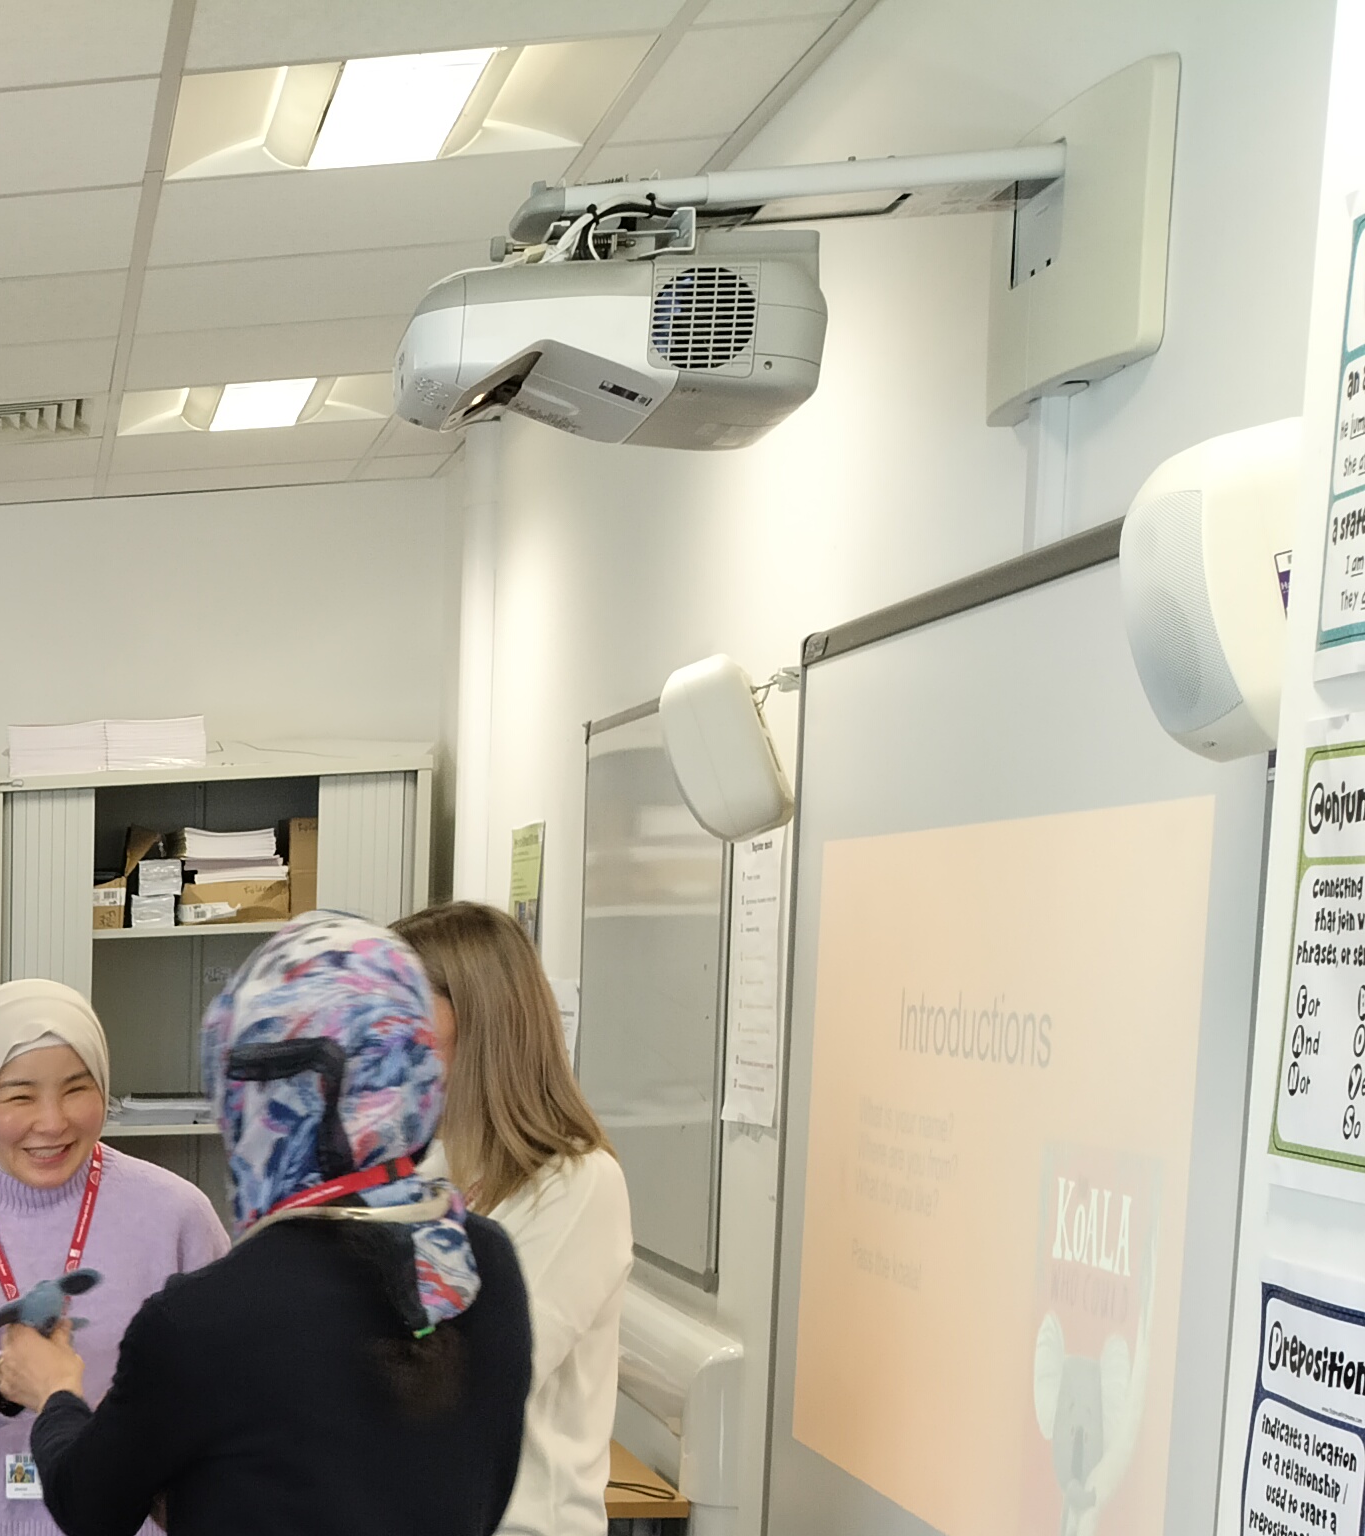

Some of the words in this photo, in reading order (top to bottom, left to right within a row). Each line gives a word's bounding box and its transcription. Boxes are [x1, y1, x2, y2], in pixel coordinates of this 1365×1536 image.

[1341, 590, 1359, 612] They
[1314, 907, 1336, 933] that
[1337, 907, 1356, 935] join
[1296, 941, 1339, 968] phrases,
[1341, 947, 1351, 965] or
[1296, 985, 1321, 1019] For
[899, 986, 1052, 1069] Introductions
[1292, 1024, 1321, 1059] And
[1287, 1061, 1311, 1096] Nor
[1342, 1104, 1361, 1140] So
[1261, 1413, 1302, 1450] indicates
[1303, 1433, 1310, 1457] a
[1312, 1434, 1358, 1473] location
[1262, 1450, 1273, 1470] or
[1274, 1453, 1280, 1476] a
[1281, 1458, 1341, 1503] relationship
[1266, 1484, 1286, 1516] used
[1288, 1493, 1298, 1514] to
[1300, 1501, 1328, 1530] start
[1330, 1511, 1337, 1535] a
